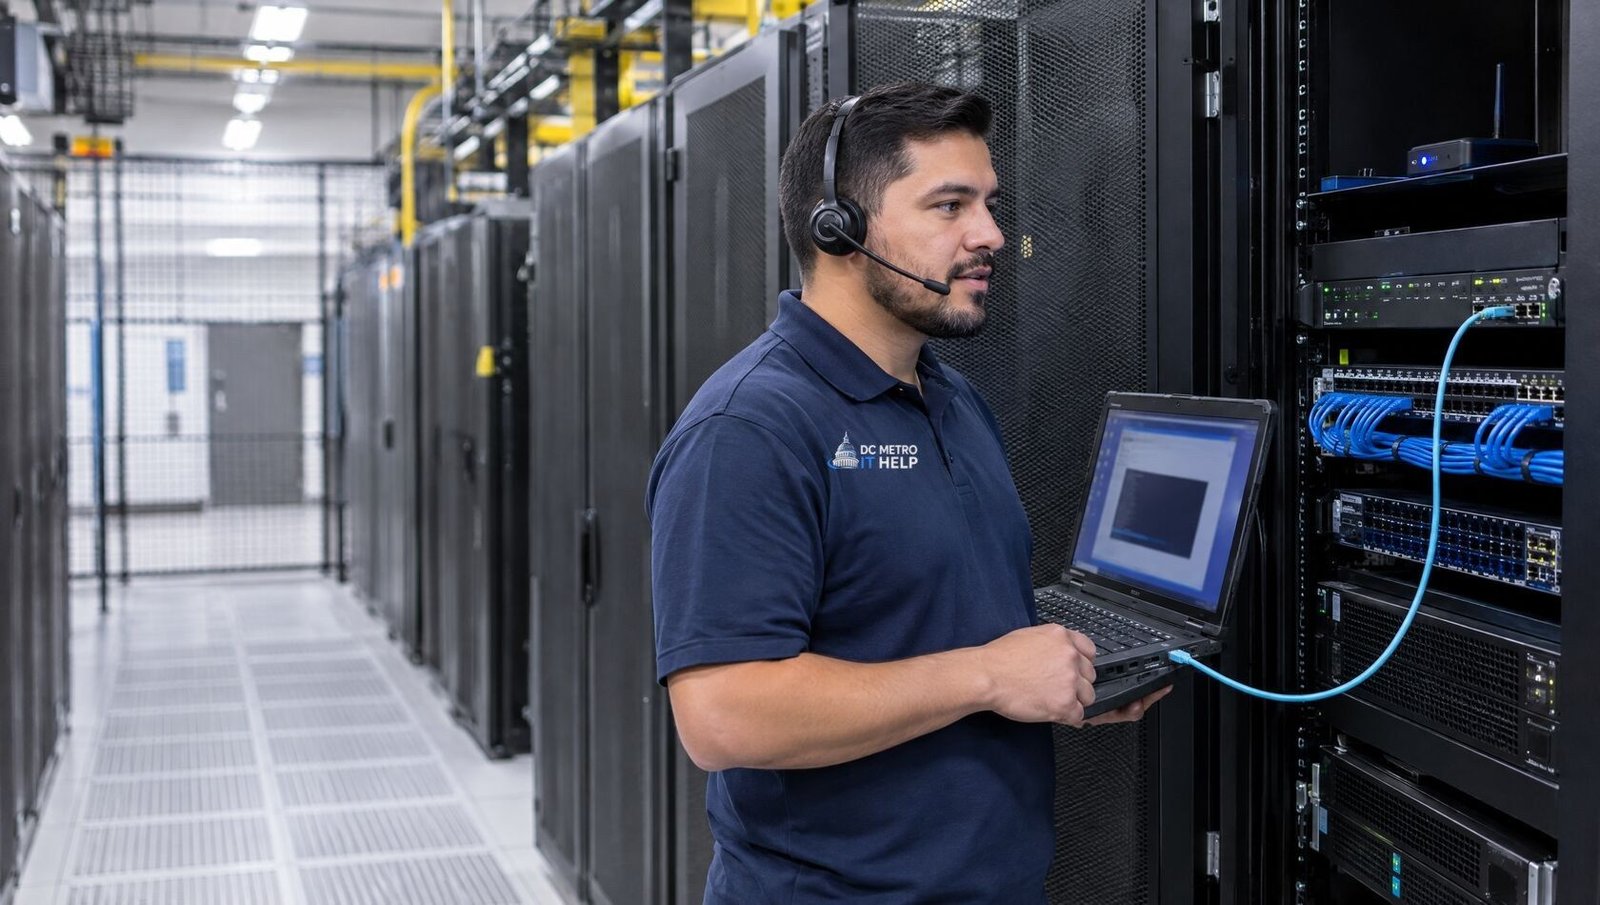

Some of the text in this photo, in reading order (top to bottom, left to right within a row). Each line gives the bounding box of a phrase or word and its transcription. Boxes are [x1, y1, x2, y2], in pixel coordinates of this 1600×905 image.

[860, 445, 918, 454] DC METRO
[860, 457, 918, 468] IT HELP
